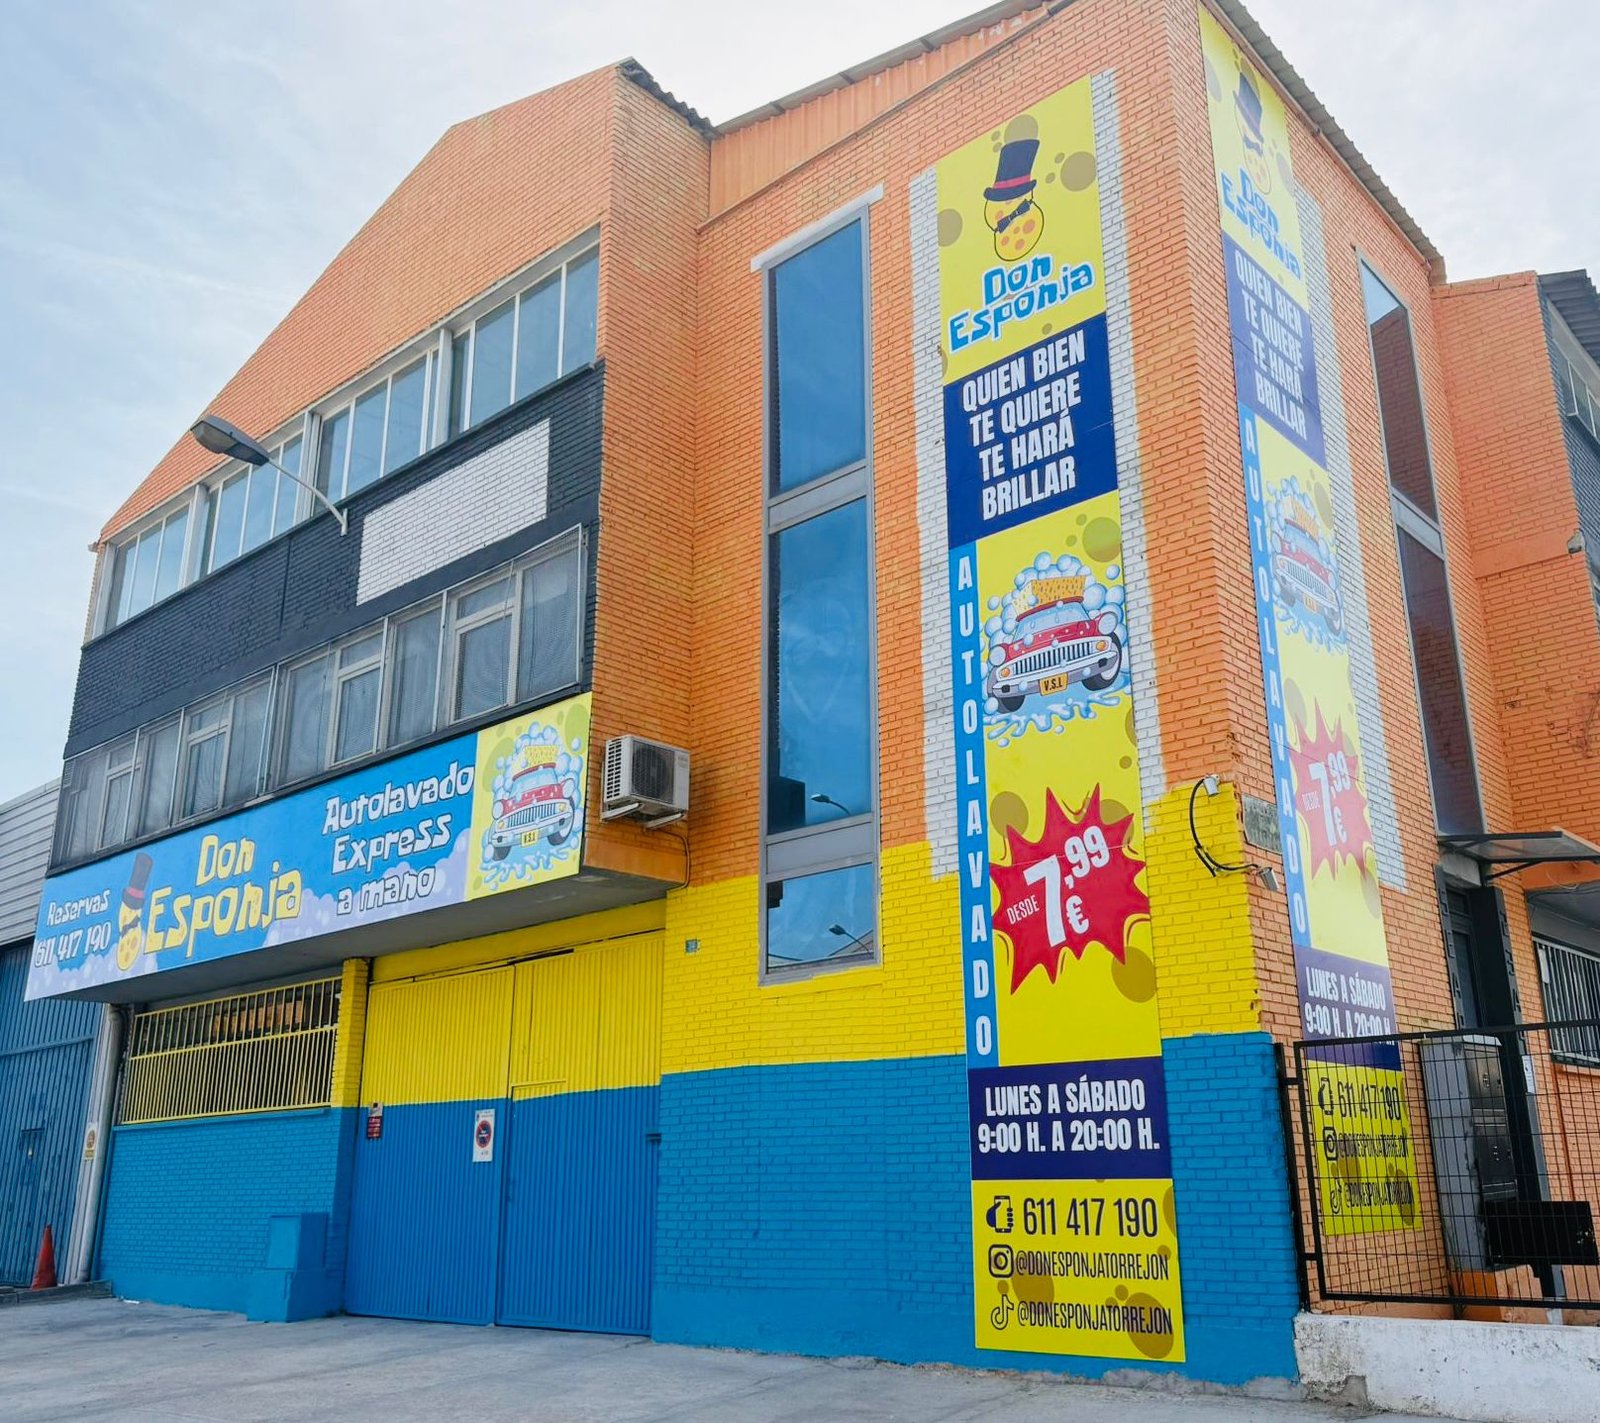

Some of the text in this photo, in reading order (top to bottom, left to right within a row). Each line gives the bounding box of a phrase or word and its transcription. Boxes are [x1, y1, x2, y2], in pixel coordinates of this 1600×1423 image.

[1220, 171, 1301, 281] Esponja
[1239, 167, 1278, 233] Don
[948, 263, 1095, 352] Esponja
[982, 254, 1053, 307] Don
[1235, 249, 1303, 338] QUIEN BIEN
[1241, 289, 1303, 371] TE QUIERE
[962, 329, 1086, 412] QUIEN BIEN
[1250, 331, 1303, 405] TE HARÁ
[969, 371, 1082, 447] TE QUIERE
[1255, 370, 1307, 441] BRILLAR
[979, 407, 1075, 481] TE HARÁ
[982, 455, 1076, 521] BRILLAR
[1245, 418, 1305, 934] AUTOLAVADO
[322, 761, 475, 835] Autolavado
[958, 555, 992, 1056] AUTOLAVADO
[195, 834, 255, 887] Don
[331, 813, 453, 875] Express
[46, 888, 111, 927] Reservas
[143, 861, 301, 958] Esponja
[336, 866, 436, 916] a mano
[1006, 894, 1040, 925] DESDE
[34, 921, 111, 967] 611 417 190
[1305, 1002, 1331, 1036] 9:00
[1332, 1007, 1345, 1038] H.
[1345, 1010, 1354, 1038] A
[1306, 966, 1386, 1011] LUNES A SÁBADO
[985, 1073, 1146, 1117] LUNES A SÁBADO
[1337, 1081, 1401, 1121] 611 417 190
[978, 1117, 1160, 1154] 9:00 H. A 20:00 H.
[1023, 1197, 1158, 1238] 611 417 190
[1016, 1250, 1169, 1280] @DONESPONJATORREJON
[1017, 1301, 1173, 1335] @DONESPONJATORREJON
